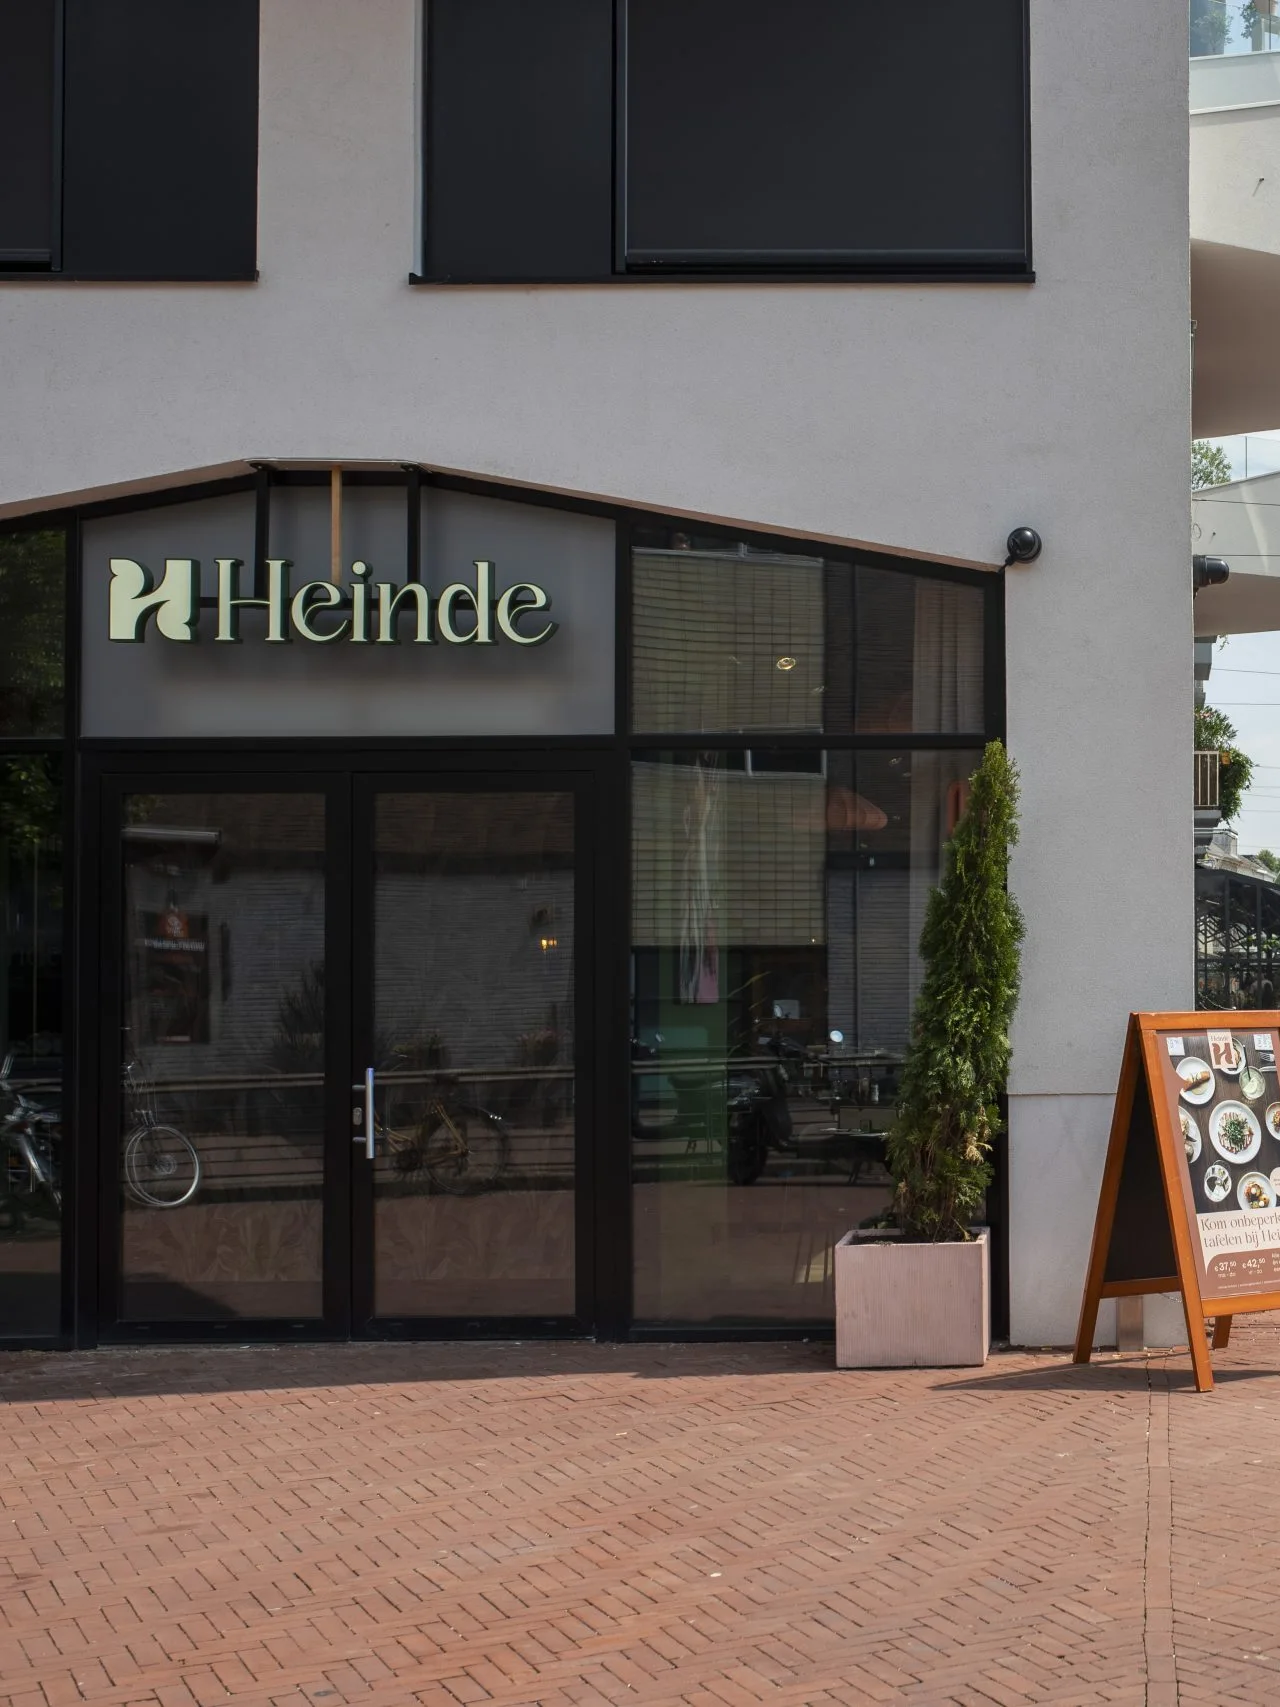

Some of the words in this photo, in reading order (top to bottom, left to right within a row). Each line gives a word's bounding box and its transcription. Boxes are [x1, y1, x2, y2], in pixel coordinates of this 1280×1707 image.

[214, 558, 557, 646] Heinde
[1201, 1218, 1227, 1231] Kom
[1204, 1233, 1242, 1248] tafelen
[1245, 1231, 1259, 1247] bij
